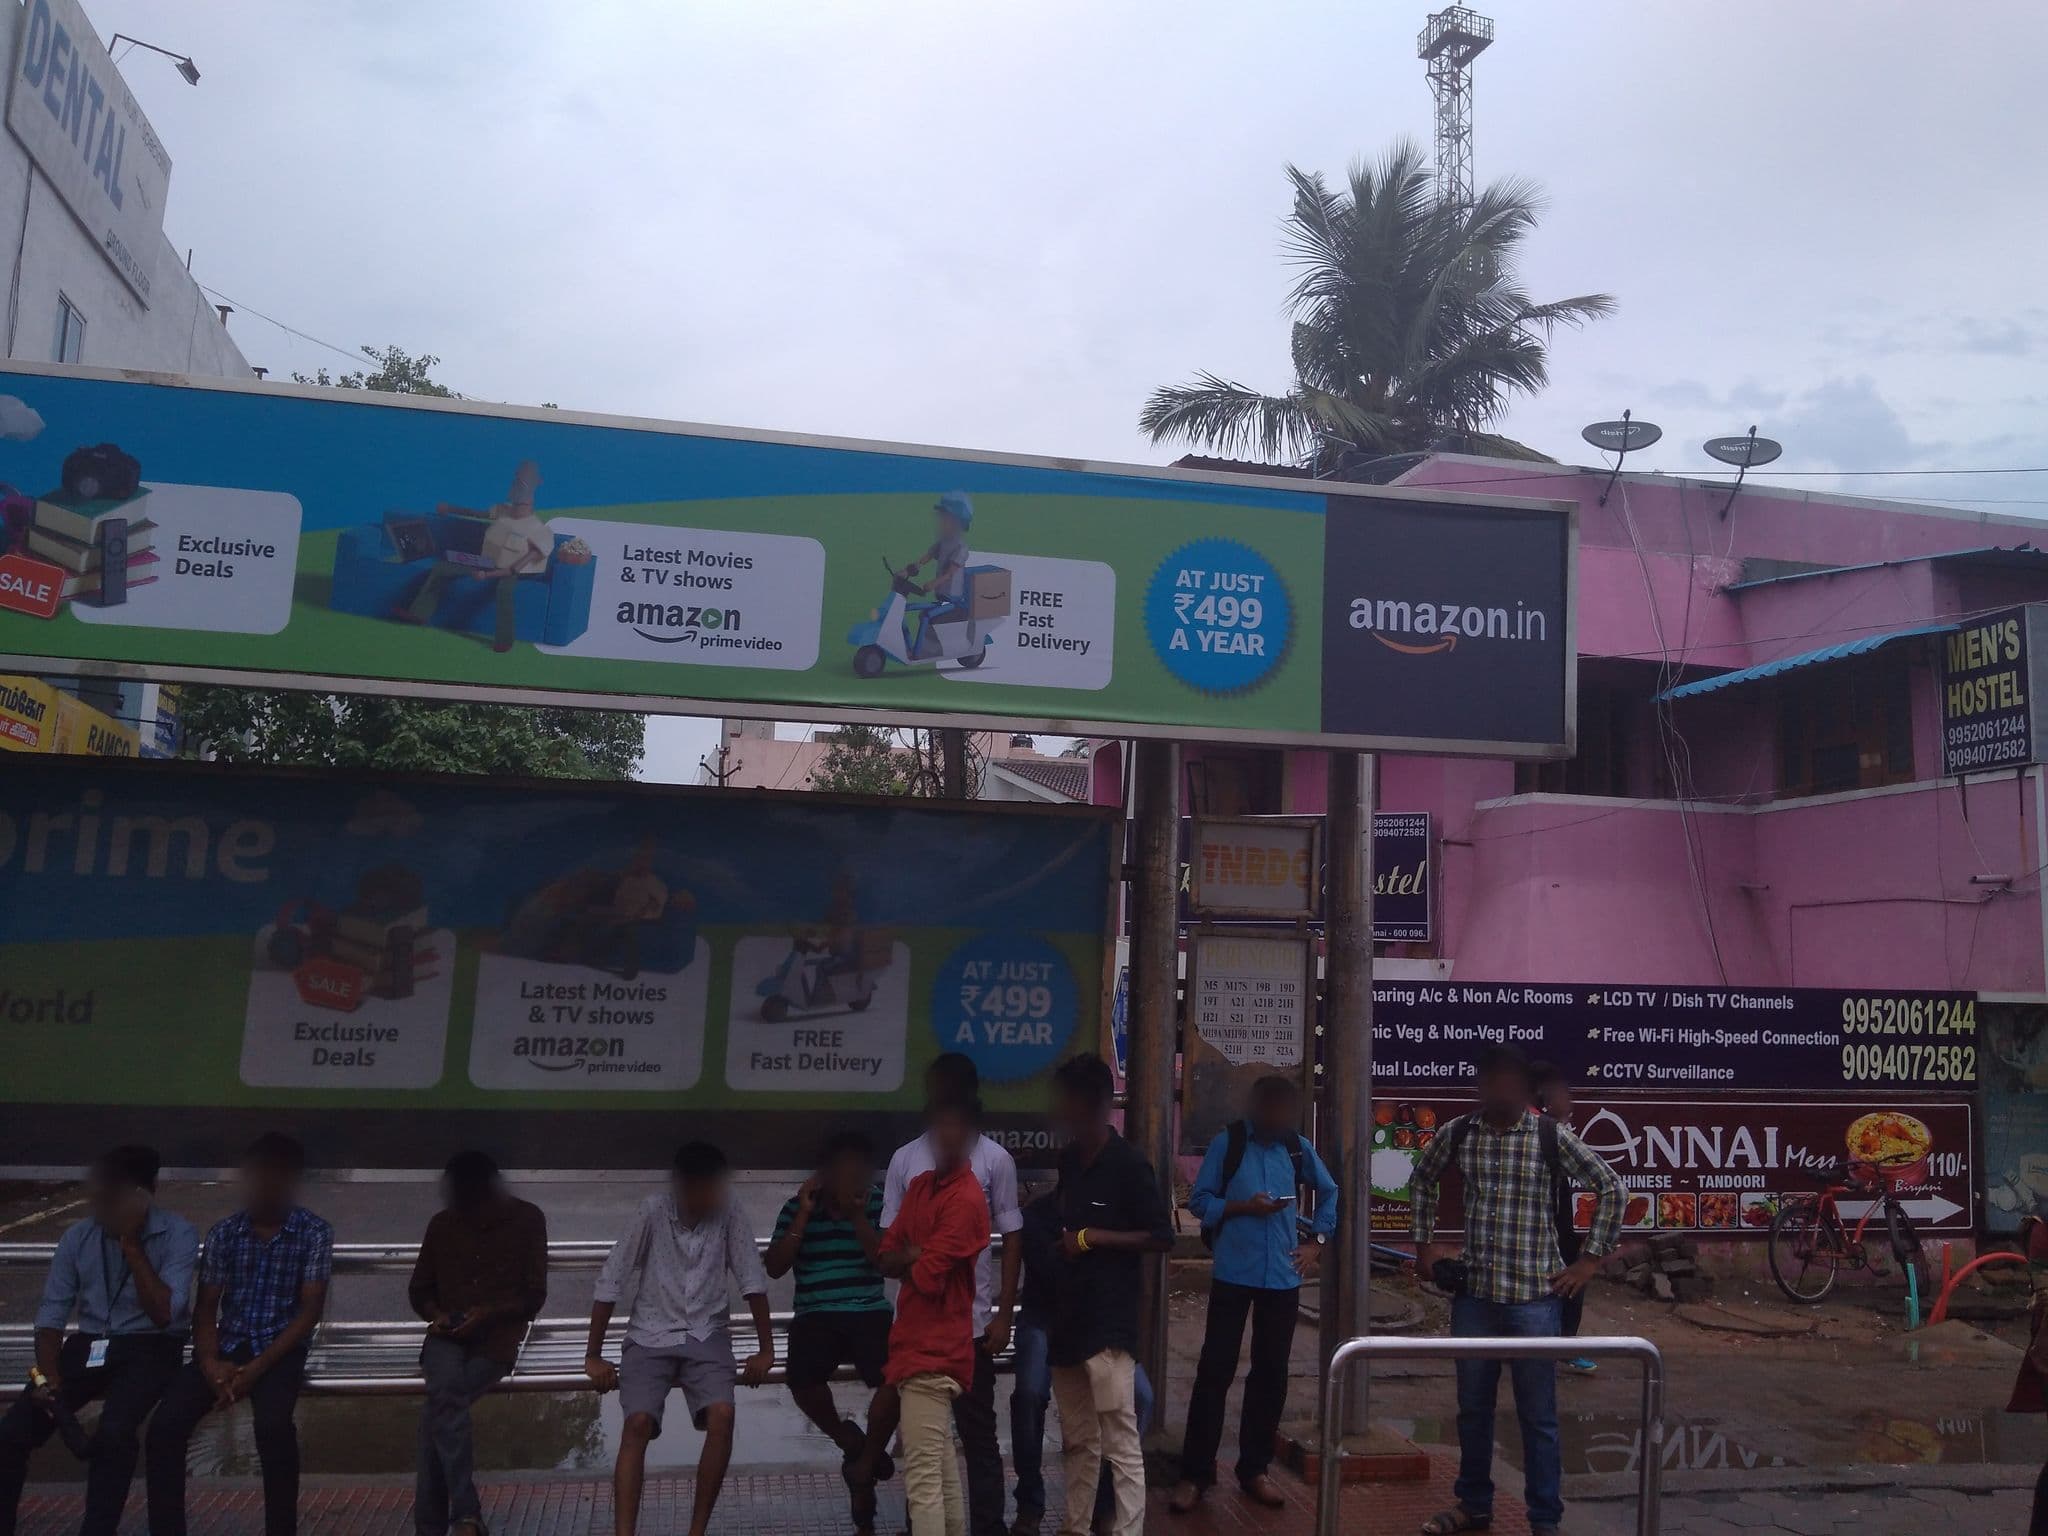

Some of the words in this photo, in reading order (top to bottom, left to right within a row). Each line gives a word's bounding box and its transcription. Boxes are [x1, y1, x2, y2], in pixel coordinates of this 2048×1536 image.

[24, 0, 124, 212] DENTAL
[178, 535, 275, 558] Exclusive
[623, 544, 682, 565] Latest
[687, 550, 753, 569] Movies
[175, 558, 234, 578] Deals
[620, 567, 636, 583] &
[642, 568, 669, 585] TV
[673, 571, 733, 590] shows
[0, 573, 51, 603] SALE
[1175, 569, 1205, 587] AT
[1210, 572, 1265, 593] JUST
[1019, 590, 1063, 608] FREE
[616, 601, 741, 630] amazon
[1018, 611, 1054, 628] Fast
[1349, 598, 1546, 640] amazon.in
[1017, 633, 1090, 655] Delivery
[1169, 629, 1190, 650] A
[1196, 630, 1265, 656] YEAR
[1947, 619, 2021, 673] MEN'S
[1948, 671, 2024, 718] HOSTEL
[1949, 715, 2026, 745] 9952061244
[1949, 738, 2026, 767] 9094072582
[1374, 860, 1427, 895] stel
[962, 961, 993, 979] AT
[997, 962, 1055, 981] JUST
[308, 975, 352, 998] SALE
[520, 981, 586, 1001] Latest
[593, 983, 667, 1002] Movies
[1419, 988, 1443, 1003] A/c
[1447, 988, 1459, 1003] &
[1463, 988, 1492, 1004] Non
[1495, 989, 1520, 1004] A/c
[1524, 990, 1573, 1005] Rooms
[0, 990, 95, 1024] orld
[1603, 991, 1632, 1006] LCD
[1637, 992, 1656, 1007] TV
[1673, 993, 1703, 1008] Dish
[1707, 993, 1726, 1008] TV
[1730, 994, 1794, 1010] Channels
[529, 1005, 545, 1023] &
[552, 1005, 581, 1024] TV
[588, 1005, 655, 1025] shows
[1842, 998, 1976, 1035] 9952061244
[294, 1022, 399, 1042] Exclusive
[793, 1030, 843, 1048] FREE
[955, 1022, 976, 1043] A
[983, 1023, 1053, 1045] YEAR
[1396, 1024, 1423, 1043] Veg
[1428, 1025, 1440, 1039] &
[1443, 1025, 1505, 1043] Non-Veg
[1509, 1026, 1544, 1040] Food
[1603, 1028, 1635, 1042] Free
[1639, 1028, 1674, 1043] Wi-Fi
[1678, 1028, 1758, 1047] High-Speed
[1762, 1030, 1840, 1046] Connection
[312, 1048, 375, 1067] Deals
[513, 1035, 625, 1058] amazon
[750, 1053, 792, 1071] Fast
[799, 1053, 883, 1076] Delivery
[1403, 1061, 1455, 1077] Locker
[1603, 1064, 1644, 1079] CCTV
[1647, 1065, 1734, 1080] Surveillance
[1842, 1045, 1976, 1081] 9094072582
[1580, 1107, 1779, 1168] ANNAI
[1785, 1144, 1839, 1170] Mess
[1927, 1152, 1967, 1177] 110/-
[1698, 1175, 1766, 1188] TANDOORI
